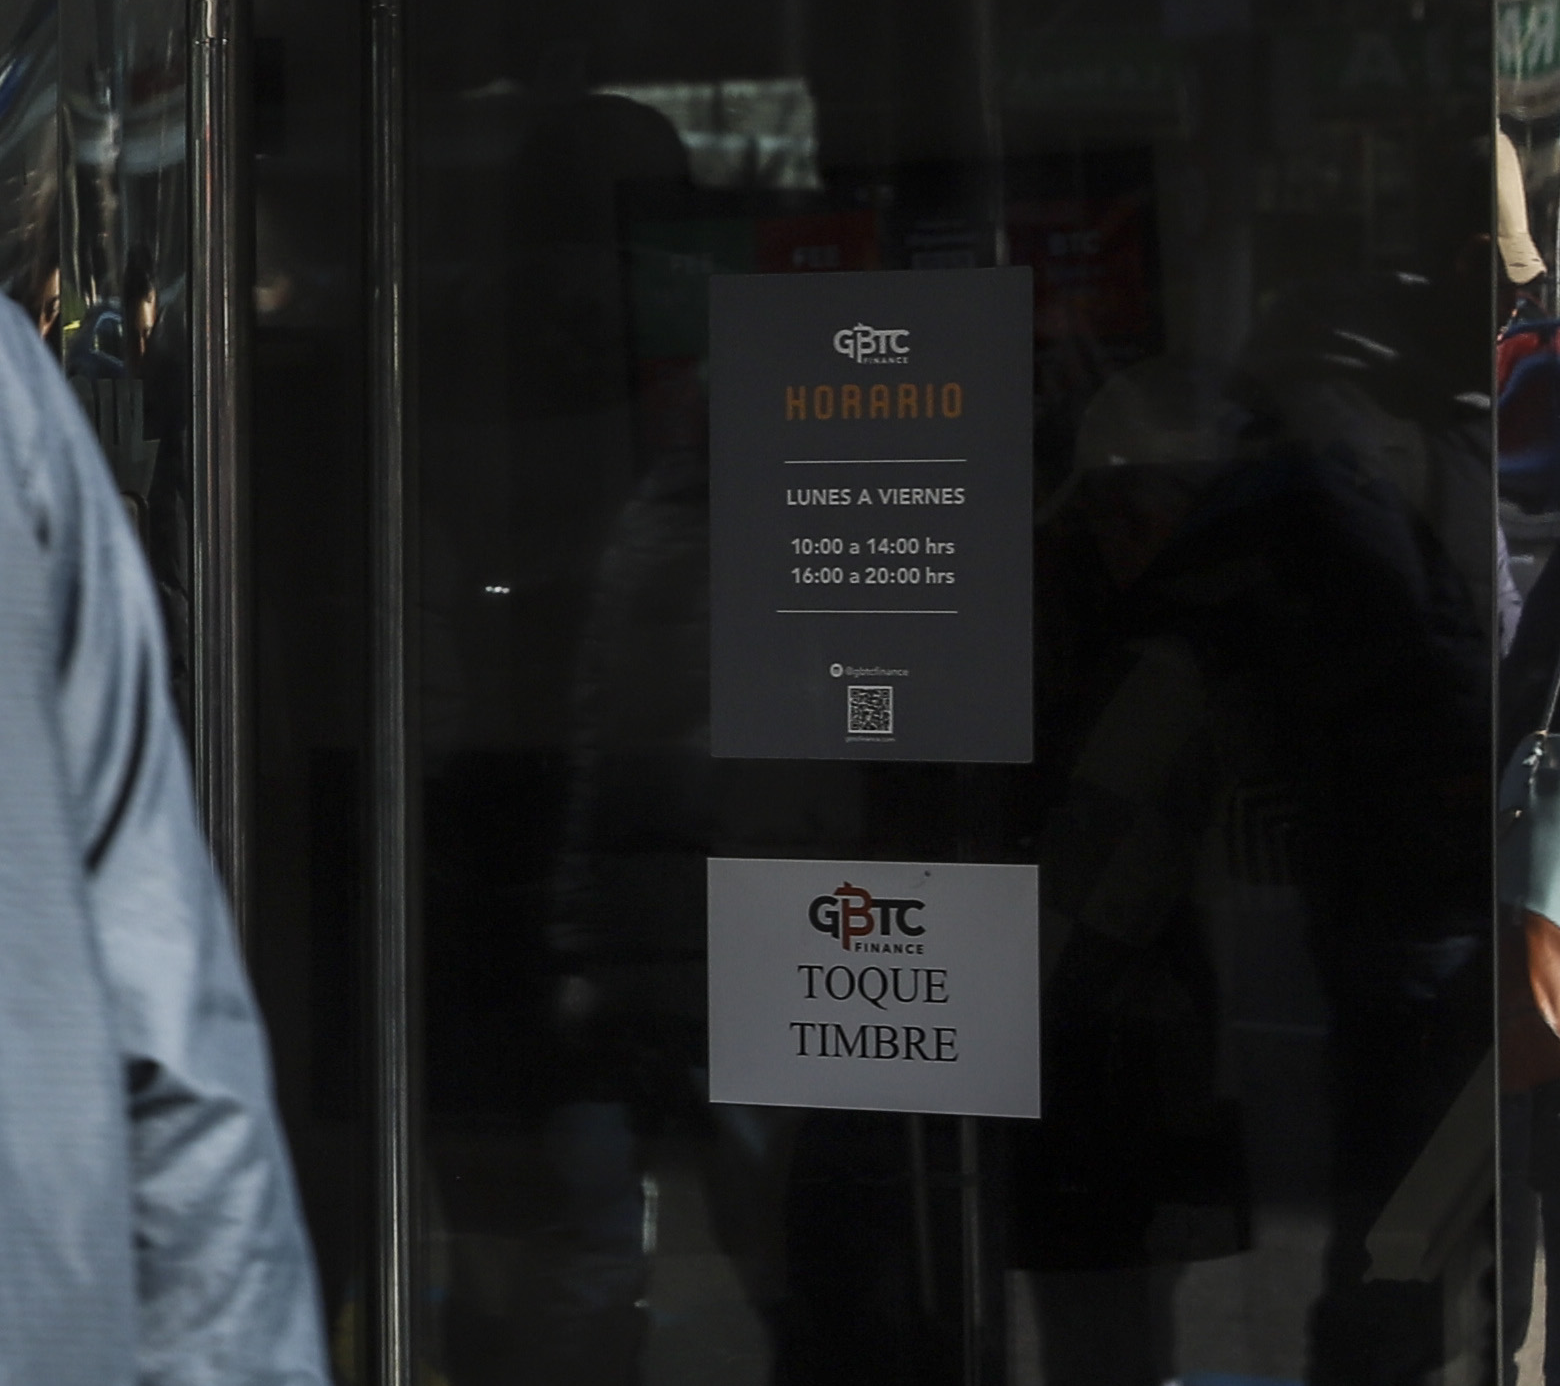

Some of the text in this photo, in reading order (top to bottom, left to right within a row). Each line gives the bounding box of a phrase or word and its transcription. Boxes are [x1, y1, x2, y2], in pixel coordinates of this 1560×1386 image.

[833, 322, 911, 365] GBTC
[785, 382, 964, 421] HORARIO
[786, 487, 966, 507] LUNES A VIERNES
[791, 536, 956, 556] 10:00 a 14:00 hrs
[791, 566, 956, 586] 16:00 a 20:00 hrs
[808, 880, 927, 952] GBTC
[854, 941, 925, 955] FINANCE
[797, 964, 950, 1010] TOQUE
[788, 1021, 960, 1063] TIMBRE
